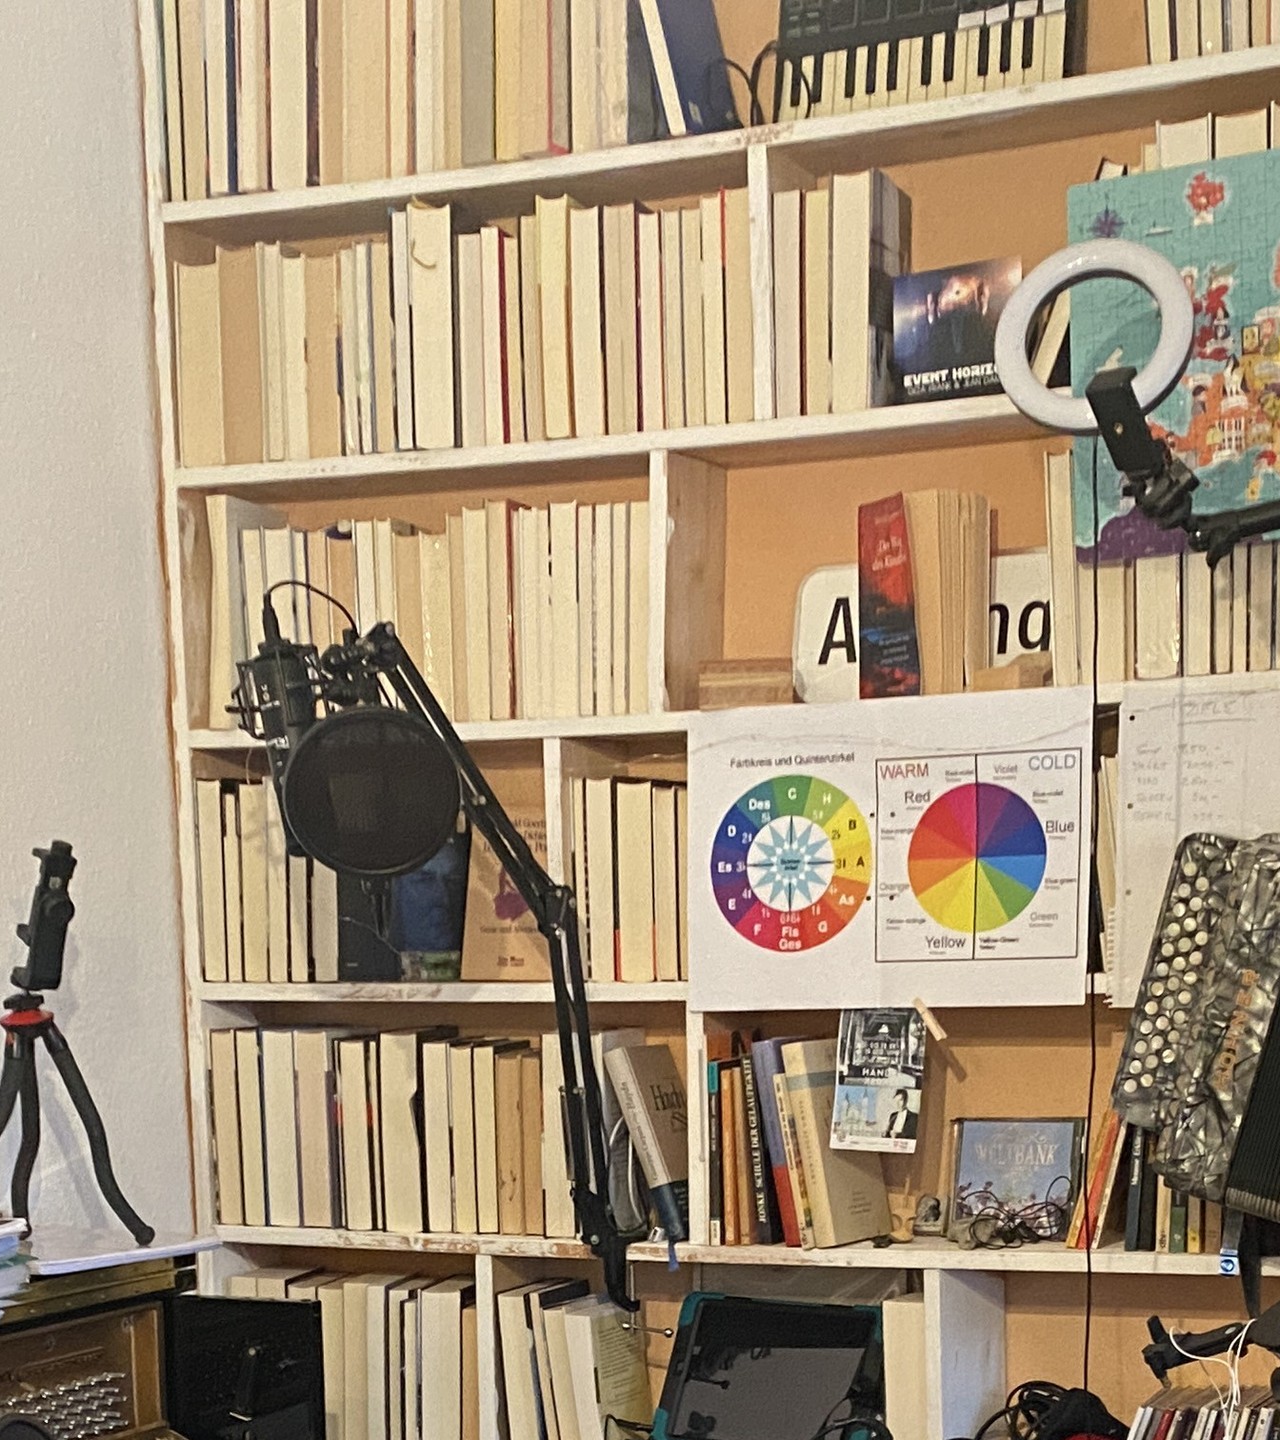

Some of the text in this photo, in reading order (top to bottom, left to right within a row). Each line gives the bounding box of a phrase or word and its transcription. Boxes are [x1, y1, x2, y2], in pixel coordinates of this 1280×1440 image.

[903, 362, 998, 388] EVENT HORIZ
[774, 755, 792, 766] und
[1028, 754, 1076, 771] COLD
[880, 763, 929, 779] WARM
[904, 789, 931, 804] Red
[748, 799, 770, 811] Des
[1045, 820, 1075, 834] Blue
[856, 857, 865, 868] A
[1029, 911, 1059, 921] Green
[925, 935, 966, 949] Yellow
[748, 1126, 761, 1149] DER
[751, 1149, 766, 1189] SCHULE
[754, 1191, 767, 1223] JONKE
